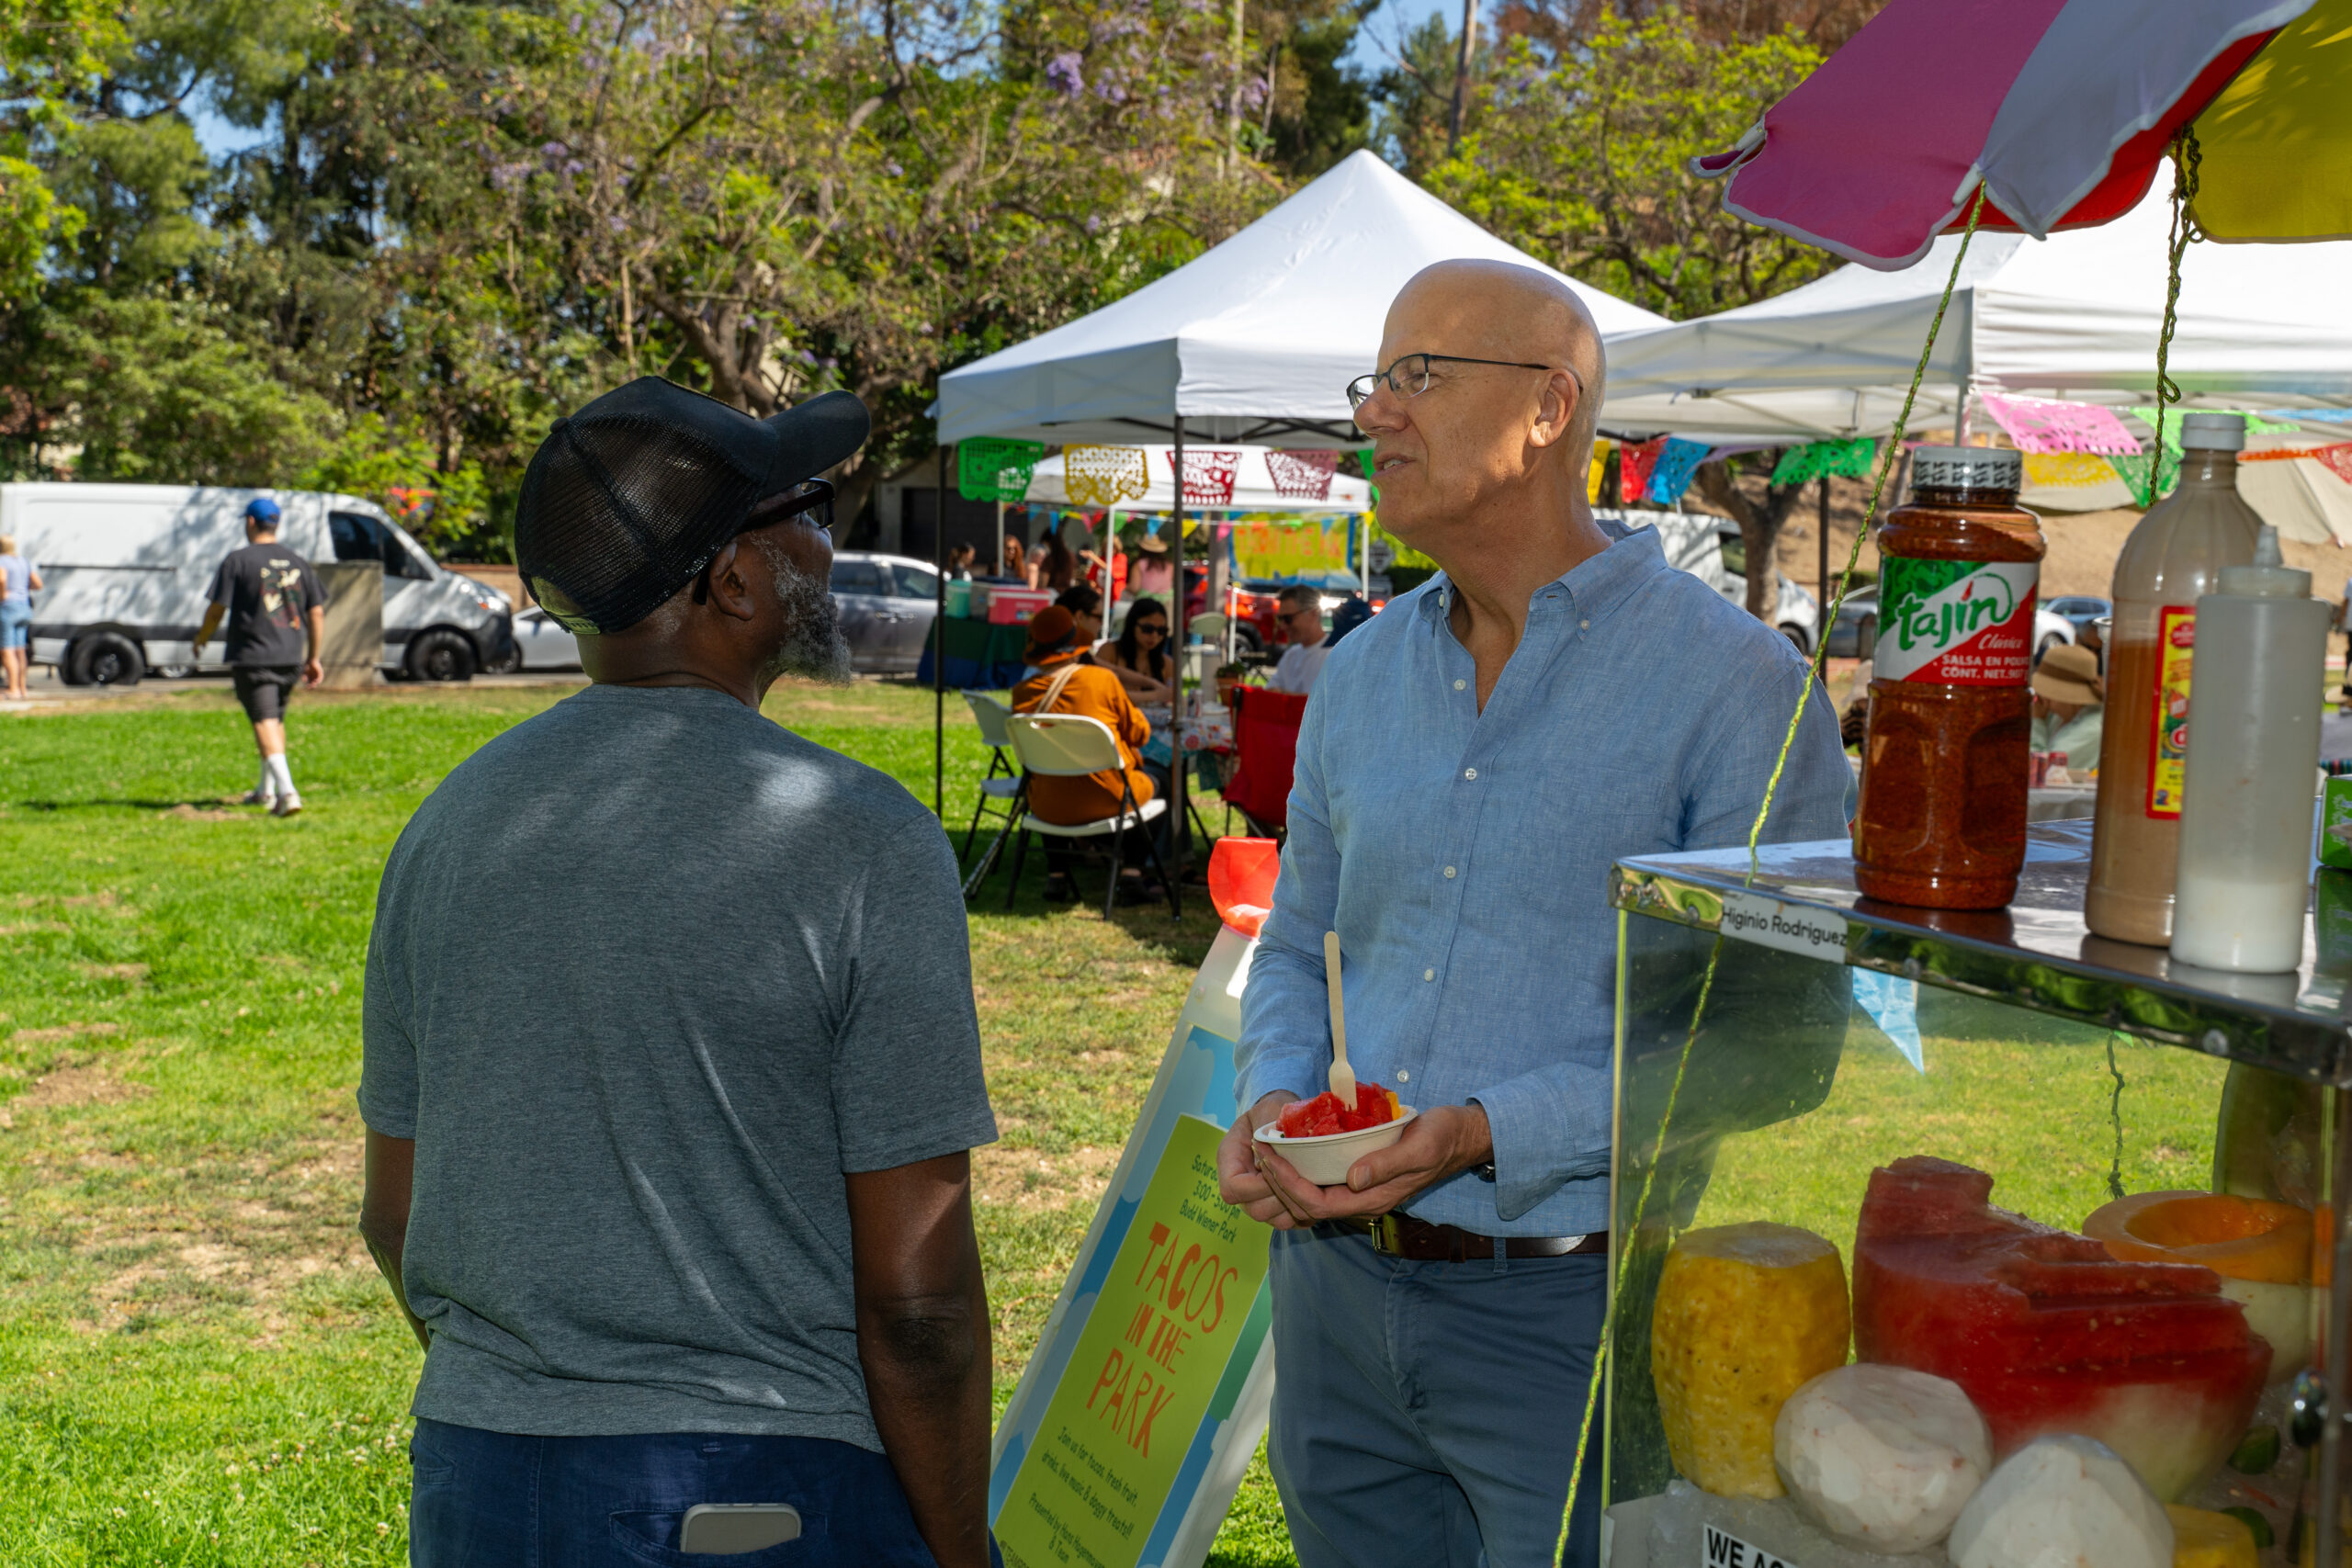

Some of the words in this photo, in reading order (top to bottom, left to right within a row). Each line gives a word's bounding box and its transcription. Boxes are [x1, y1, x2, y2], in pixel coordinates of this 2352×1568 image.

[1941, 654, 1983, 667] SALSA
[1985, 655, 2002, 667] EN
[1941, 666, 1981, 680] CONT.
[1722, 906, 1769, 931] Higinio
[1771, 914, 1848, 947] Rodriguez
[1180, 1199, 1199, 1221] Budd
[1196, 1207, 1220, 1233] Wiener
[1217, 1220, 1238, 1244] Park
[1227, 1205, 1241, 1221] pm
[1135, 1221, 1238, 1334] TACOS
[1125, 1302, 1156, 1348] IN
[1147, 1314, 1192, 1375] THE
[1086, 1348, 1176, 1460] PARK
[1057, 1426, 1072, 1448] Join
[1070, 1439, 1079, 1454] us
[1078, 1443, 1088, 1461] for
[1105, 1469, 1123, 1493] fresh
[1058, 1463, 1070, 1483] live
[1069, 1476, 1085, 1496] music
[1082, 1485, 1091, 1502] &
[1089, 1492, 1108, 1520] doggy
[1029, 1492, 1057, 1527] Presented
[1053, 1514, 1062, 1535] by
[1055, 1540, 1069, 1565] Team
[1707, 1528, 1745, 1568] WE
